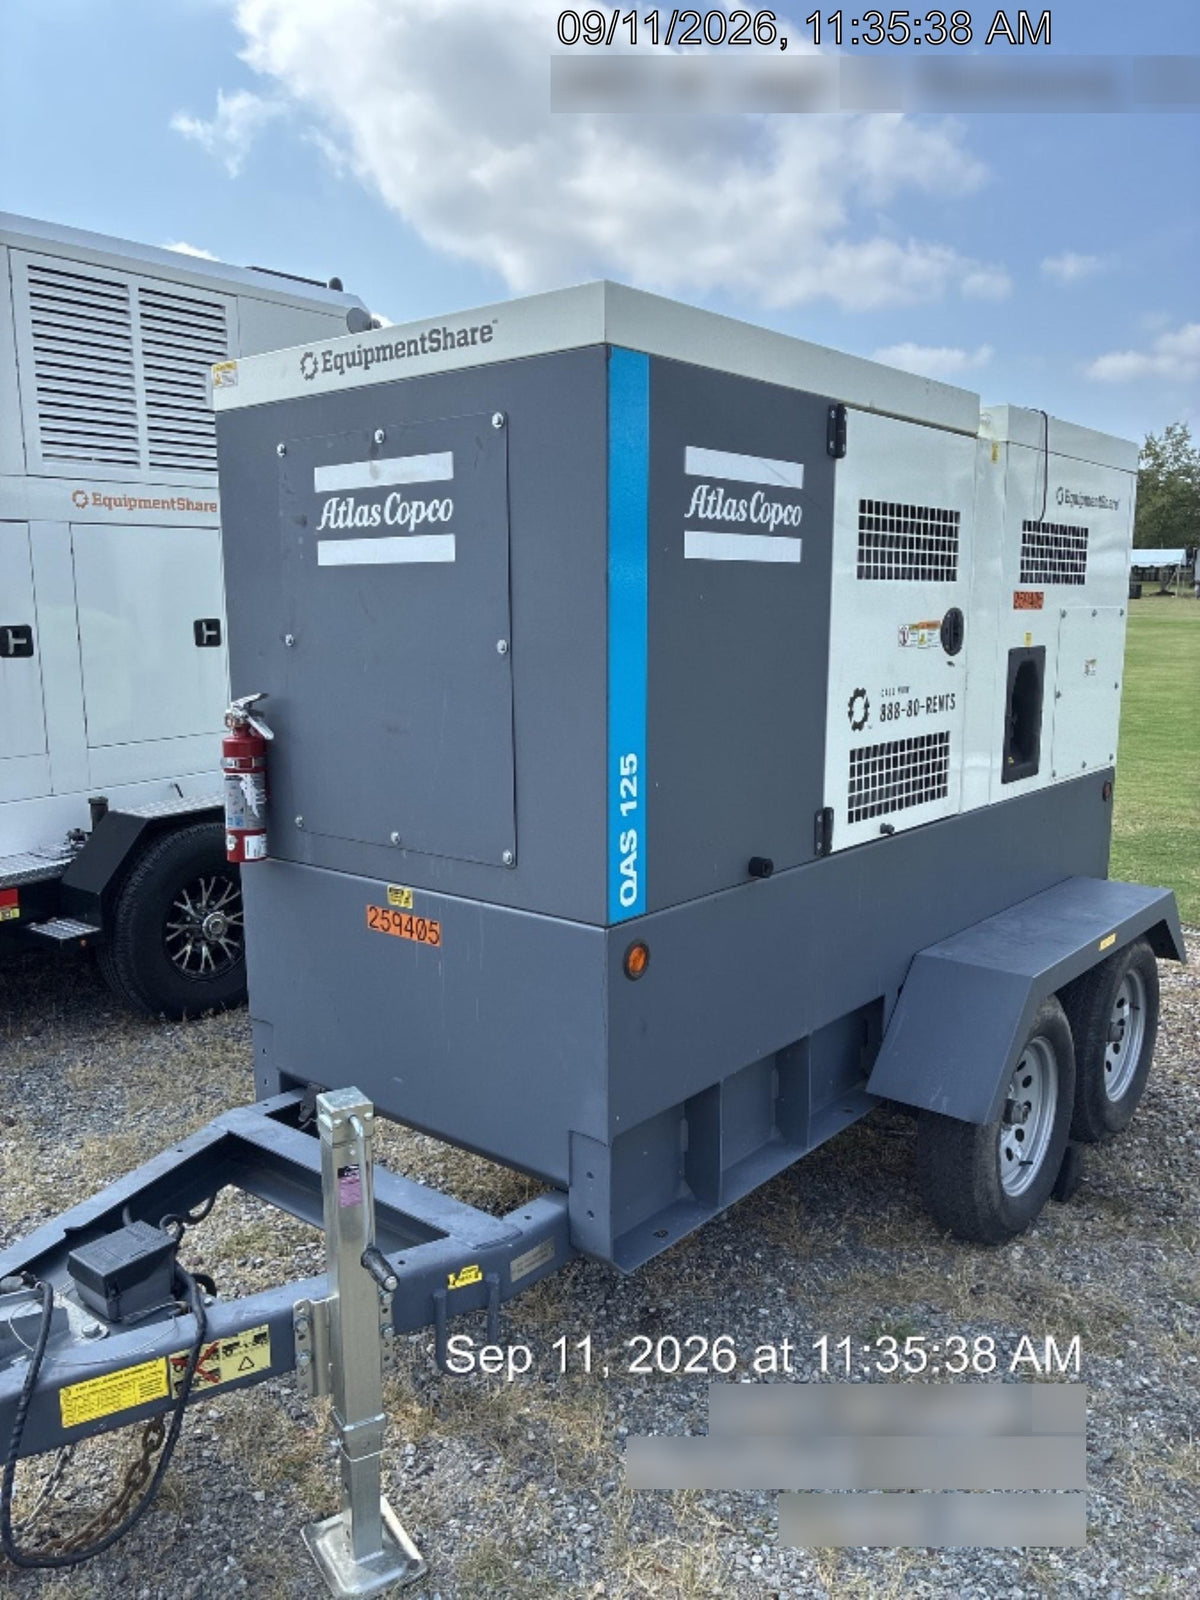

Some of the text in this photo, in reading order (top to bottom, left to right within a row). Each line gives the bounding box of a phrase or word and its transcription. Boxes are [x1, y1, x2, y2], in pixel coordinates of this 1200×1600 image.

[321, 325, 494, 375] EquipmentShare
[91, 492, 218, 513] EquipmentShare
[880, 693, 956, 722] 888-80-RENTS
[619, 753, 638, 908] QAS 125
[369, 906, 440, 945] 259405
